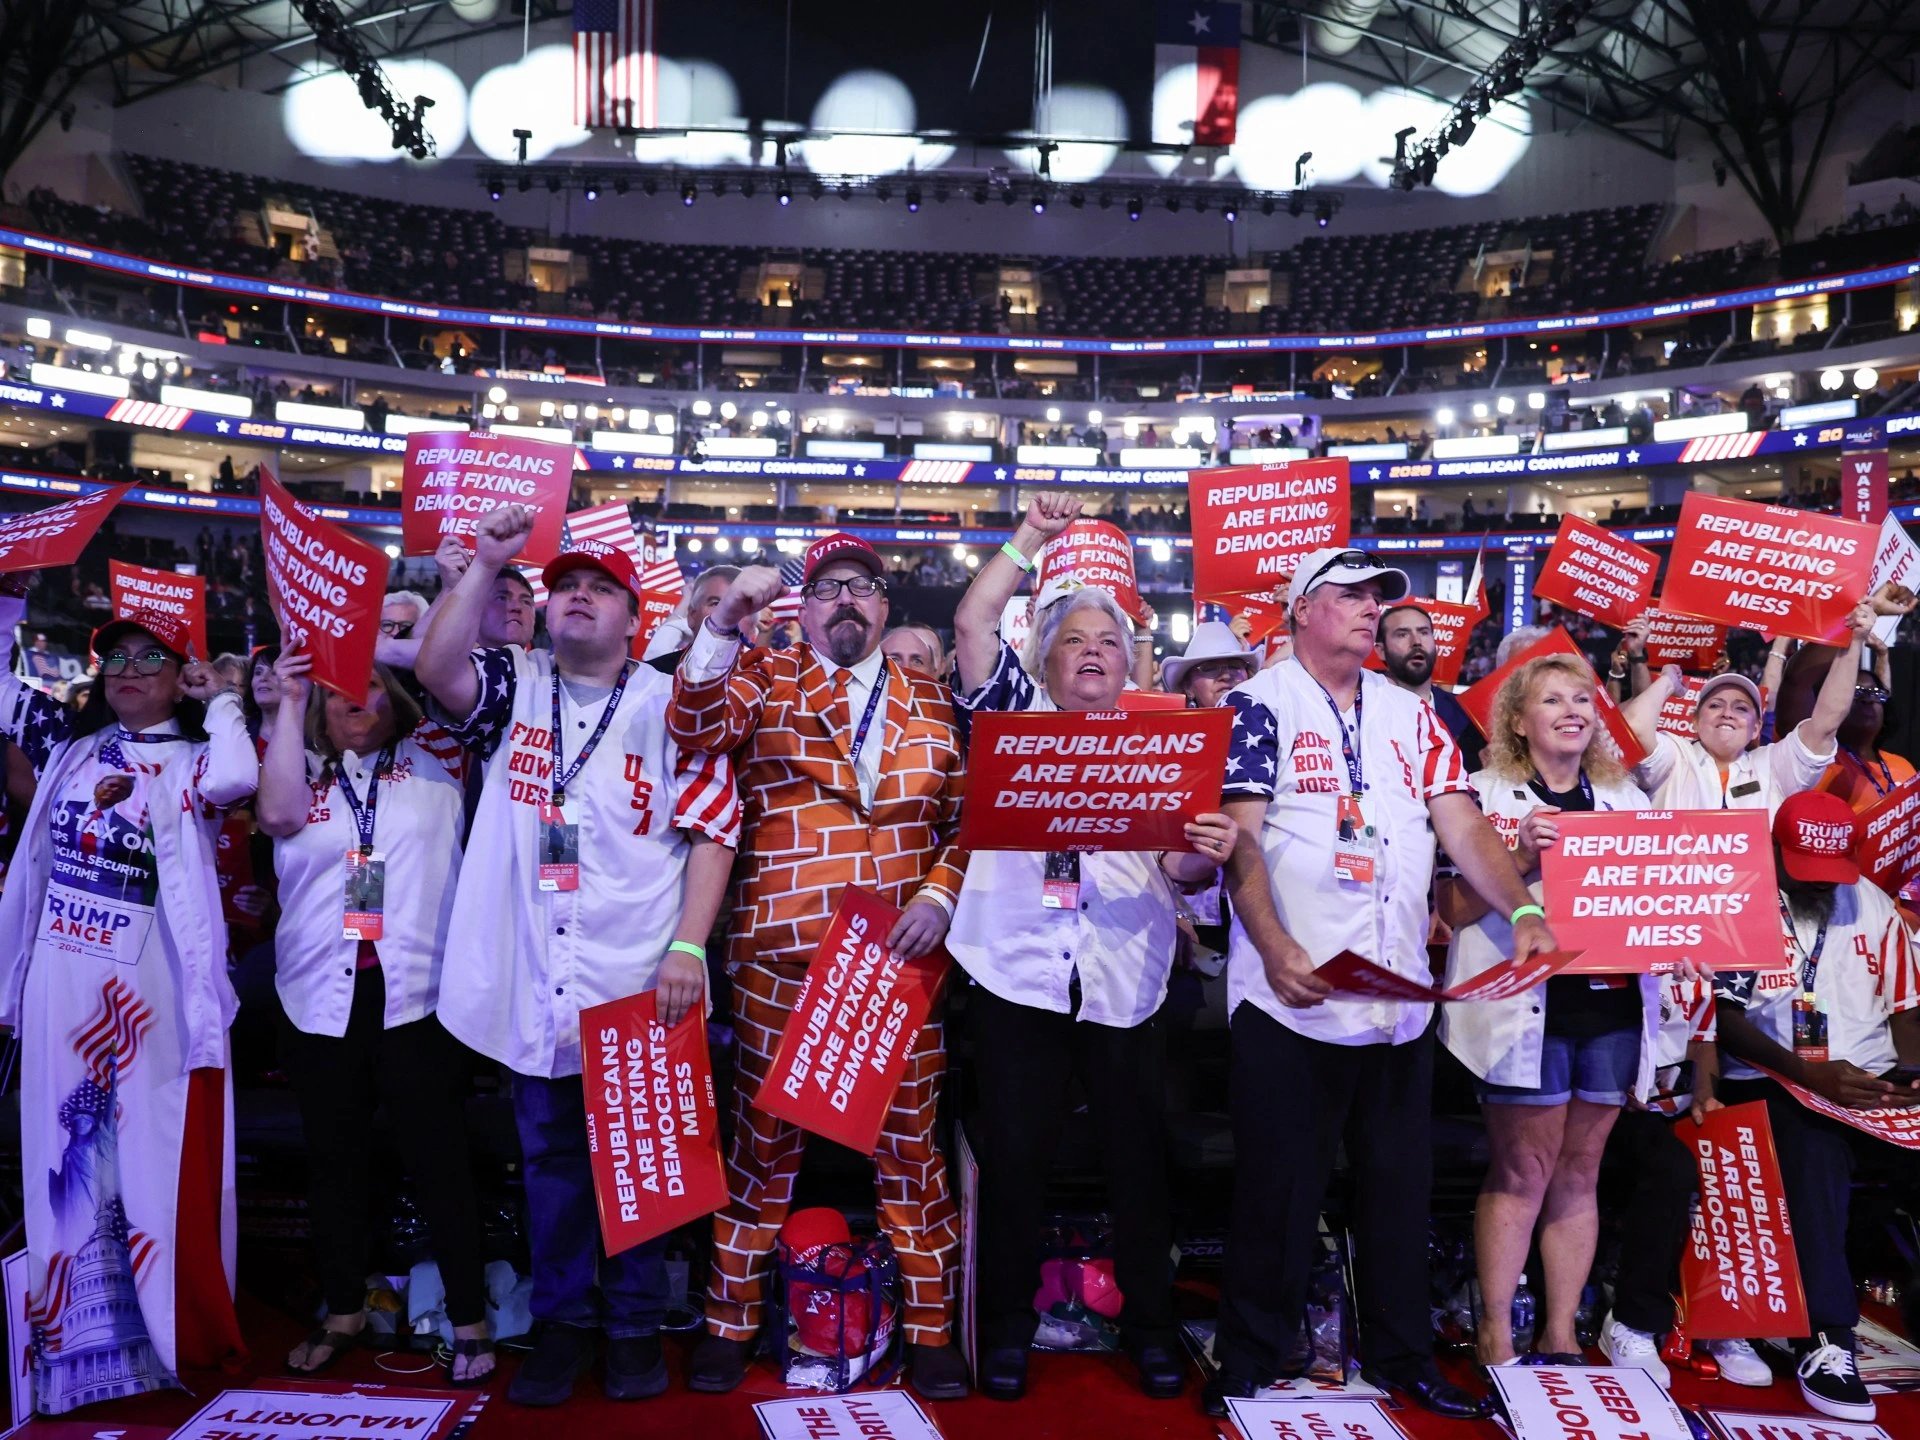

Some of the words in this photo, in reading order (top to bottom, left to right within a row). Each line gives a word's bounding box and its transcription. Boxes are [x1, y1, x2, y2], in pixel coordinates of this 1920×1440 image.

[1775, 284, 1806, 297] DALLAS
[291, 428, 380, 449] REPUBLICAN
[468, 431, 499, 440] DALLAS
[1817, 427, 1844, 443] 20
[415, 448, 556, 476] REPUBLICANS
[762, 462, 848, 475] CONVENTION
[1262, 462, 1289, 472] DALLAS
[1438, 460, 1525, 476] REPUBLICAN
[1528, 452, 1620, 471] CONVENTION
[422, 471, 460, 488] ARE
[461, 472, 537, 497] FIXING
[1060, 470, 1141, 483] REPUBLICAN
[1143, 471, 1188, 483] CONVE
[1207, 476, 1337, 507] REPUBLICANS
[1854, 461, 1874, 523] WASHI
[293, 500, 317, 522] DALLAS
[1222, 508, 1265, 530] ARE
[1269, 501, 1329, 525] FIXING
[1765, 505, 1799, 518] DALLAS
[438, 517, 480, 537] MES
[1215, 524, 1336, 555] DEMOCRATS'
[1608, 531, 1625, 543] DALLAS
[1695, 513, 1859, 556] REPUBLICANS
[264, 494, 369, 586] REPUBLICANS
[563, 539, 615, 555] RUMP
[1567, 529, 1650, 574] REPUBLICANS
[1879, 533, 1901, 567] THE
[268, 531, 286, 567] ARE
[286, 558, 348, 607] FIXING
[1047, 551, 1077, 573] ARE
[1080, 550, 1129, 570] FIXING
[1569, 549, 1596, 568] ARE
[1598, 557, 1639, 586] FIXING
[1704, 540, 1755, 562] ARE
[1755, 547, 1837, 577] FIXING
[1890, 547, 1915, 586] RITY
[116, 574, 194, 600] REPUBLICANS
[1557, 561, 1640, 603] DEMOCRATS'
[1690, 560, 1844, 601] DEMOCRATS'
[122, 592, 141, 607] ARE
[141, 597, 185, 615] FIXING
[266, 554, 355, 639] DEMOCRATS'
[1512, 563, 1526, 632] NEBRAS
[1573, 586, 1613, 610] MESS
[1725, 590, 1793, 616] MESS
[141, 614, 179, 633] ABOUT
[1647, 621, 1672, 632] ARE
[1674, 623, 1715, 634] FIXING
[1739, 620, 1769, 632] 2026
[1646, 634, 1718, 647] EMOCRATS'
[1658, 648, 1694, 659] MESS
[875, 669, 886, 690] DALLAS
[609, 687, 623, 709] DALLAS
[1663, 701, 1685, 714] RE
[1085, 712, 1128, 721] DALLAS
[851, 742, 862, 763] ALLAS
[994, 732, 1206, 755] REPUBLICANS
[509, 751, 554, 781] ROW
[554, 755, 562, 783] DALLAS
[560, 762, 581, 787] DALLAS
[1010, 764, 1077, 783] ARE
[1079, 763, 1183, 784] FIXING
[1293, 753, 1333, 773] ROW
[1295, 777, 1341, 794] JOES
[544, 804, 552, 818] 1
[994, 790, 1192, 811] DEMOCRATS'
[1343, 798, 1350, 811] 1
[364, 807, 375, 834] DALLAS
[1046, 816, 1132, 834] MESS
[1636, 811, 1674, 820] DALLAS
[1867, 791, 1920, 839] REPUBL
[75, 813, 120, 844] TAX
[1796, 820, 1853, 838] TRUMP
[1879, 820, 1910, 851] ARE
[1562, 833, 1750, 857] REPUBLICANS
[1800, 836, 1849, 850] 2028
[53, 860, 99, 882] ERTIME
[87, 854, 151, 879] SECURITY
[1339, 856, 1355, 865] SPECIAL
[1581, 866, 1638, 887] ARE
[1643, 863, 1735, 886] FIXING
[1572, 893, 1751, 918] DEMOCRATS'
[50, 918, 114, 946] ANCE
[1625, 924, 1703, 947] MESS
[58, 942, 82, 954] 2024
[1650, 962, 1675, 971] 202
[794, 974, 813, 1013] DALLAS
[1758, 973, 1798, 991] JOES
[782, 912, 870, 1100] REPUBLICANS
[813, 1031, 845, 1093] ARE
[835, 942, 882, 1033] FIXING
[829, 952, 906, 1114] DEMOCRATS
[870, 997, 910, 1076] MESS
[902, 1029, 919, 1062] 2026
[625, 1037, 651, 1132] FIXING
[703, 1074, 716, 1108] 2026
[648, 1019, 685, 1197] DEMOCRATS'
[675, 1061, 700, 1137] MESS
[586, 1113, 599, 1153] DALLAS
[600, 1026, 640, 1223] REPUBLICANS
[635, 1137, 660, 1194] ARE
[1718, 1145, 1744, 1201] ARE
[1697, 1138, 1740, 1311] DEMOCRATS'
[1736, 1126, 1787, 1314] REPUBLICANS
[1777, 1197, 1791, 1236] DALLAS
[1730, 1206, 1761, 1297] FIXING
[1533, 1370, 1596, 1440] MAJOR
[1585, 1374, 1641, 1424] KEEP
[206, 1409, 428, 1430] MAJORITY
[797, 1407, 840, 1440] THE
[842, 1400, 898, 1440] ORITY
[1510, 1408, 1525, 1430] 2026
[1668, 1407, 1688, 1433] DALLAS
